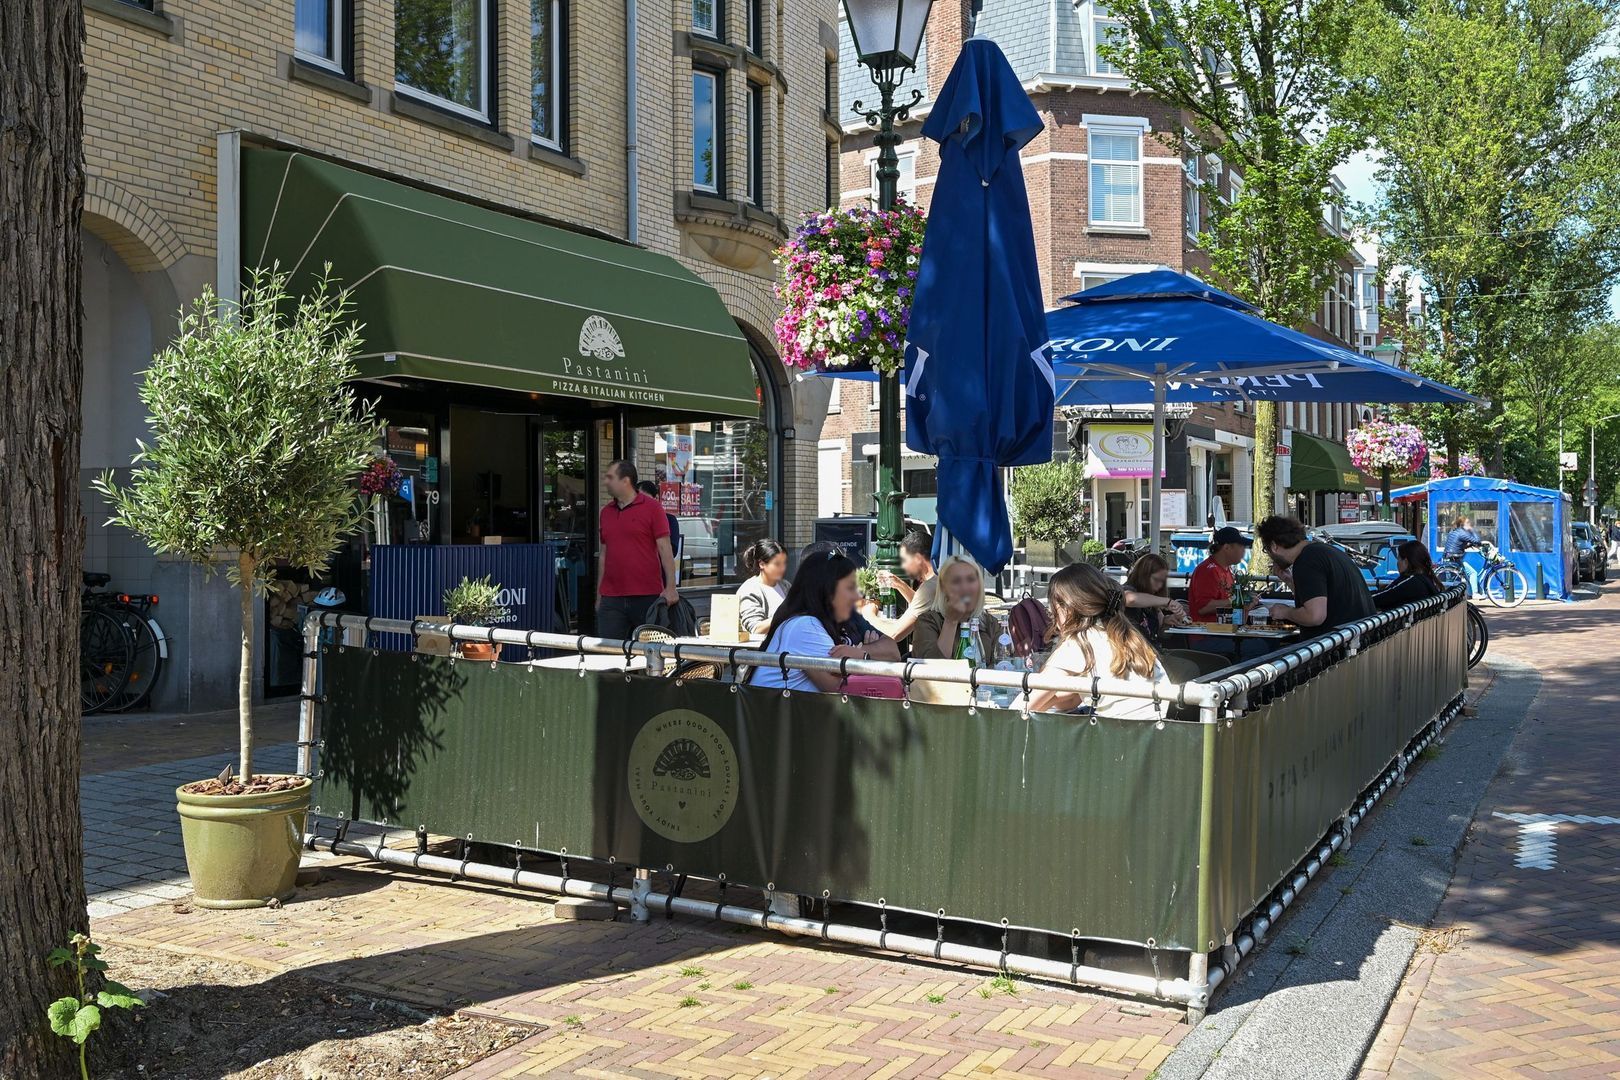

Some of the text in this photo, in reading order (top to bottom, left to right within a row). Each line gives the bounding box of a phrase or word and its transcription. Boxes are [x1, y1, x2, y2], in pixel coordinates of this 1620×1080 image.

[563, 357, 649, 383] Pastanini
[552, 381, 664, 402] PIZZA & ITALIAN KITCHEN
[424, 490, 440, 505] 79
[681, 494, 700, 505] SALE
[656, 720, 682, 732] WHERE
[686, 720, 707, 733] GOOD
[710, 734, 725, 755] FOOD
[651, 781, 711, 798] Pastanini
[640, 794, 653, 815] YOUR
[713, 799, 726, 818] LOVE
